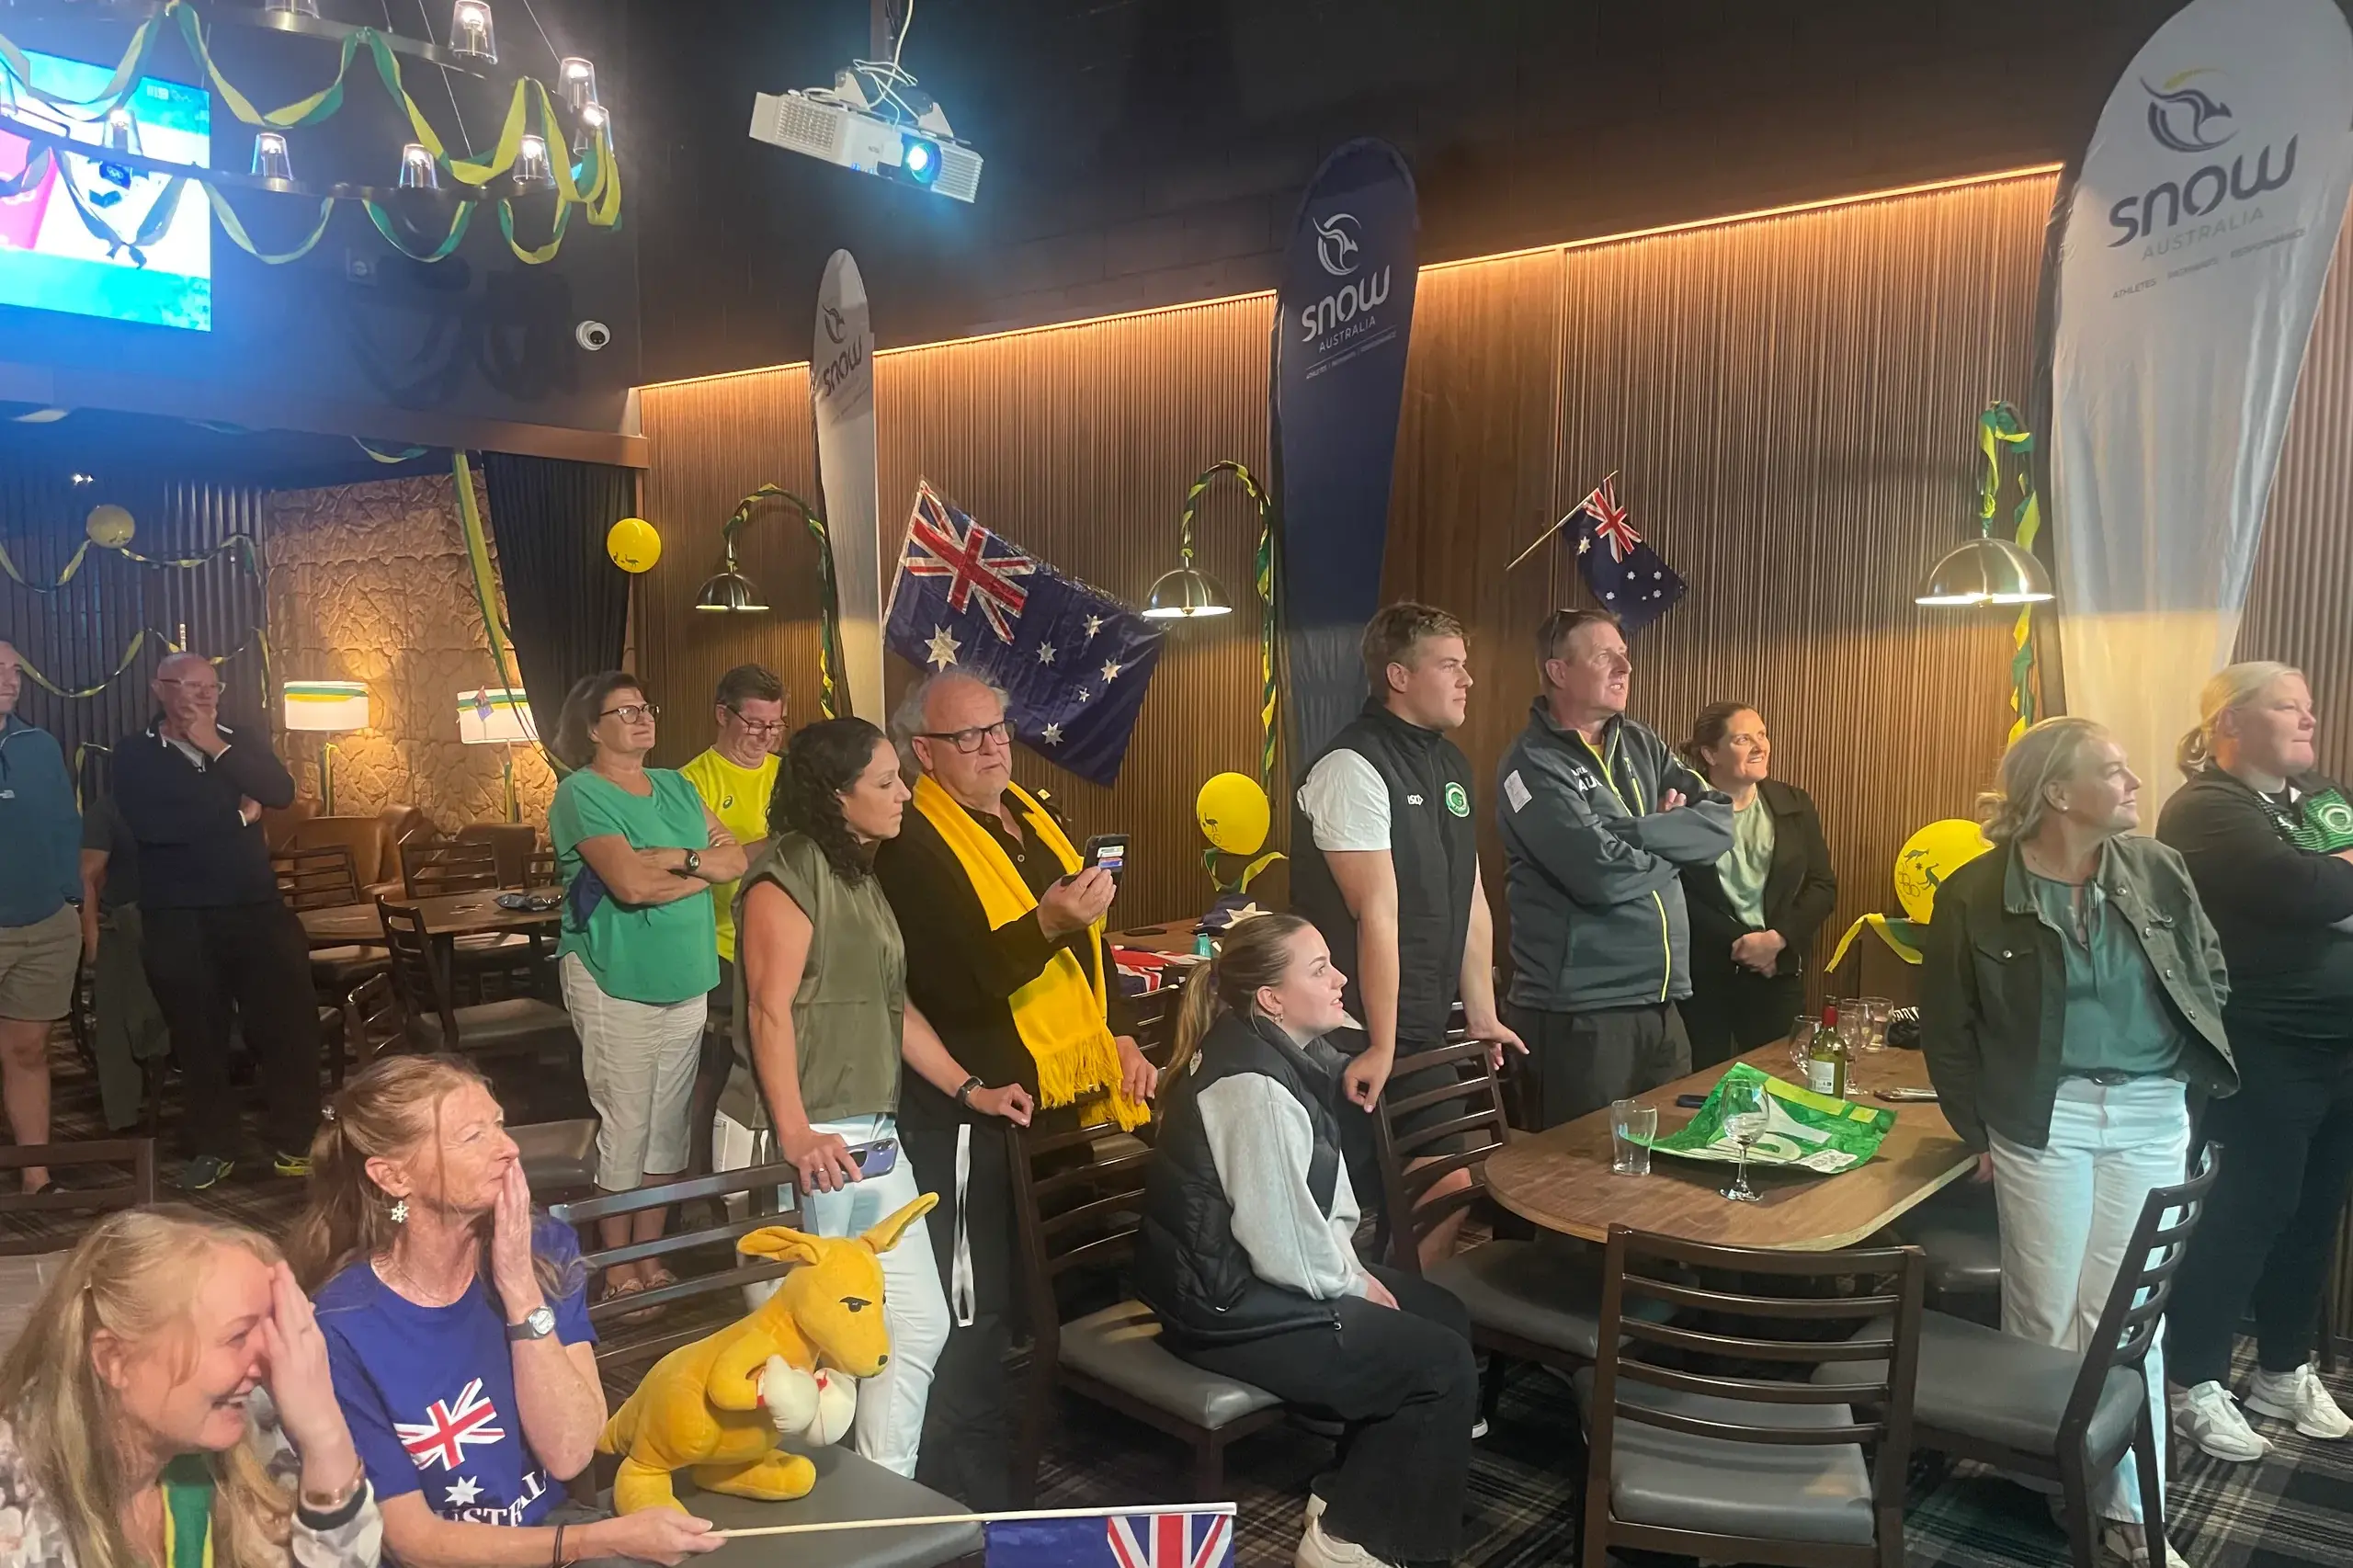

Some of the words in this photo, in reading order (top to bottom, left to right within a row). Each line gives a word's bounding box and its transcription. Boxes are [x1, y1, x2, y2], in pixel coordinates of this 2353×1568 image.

[2142, 207, 2264, 261] AUSTRALIA
[2112, 278, 2157, 299] ATHLETES
[1319, 316, 1376, 353] AUSTRALIA
